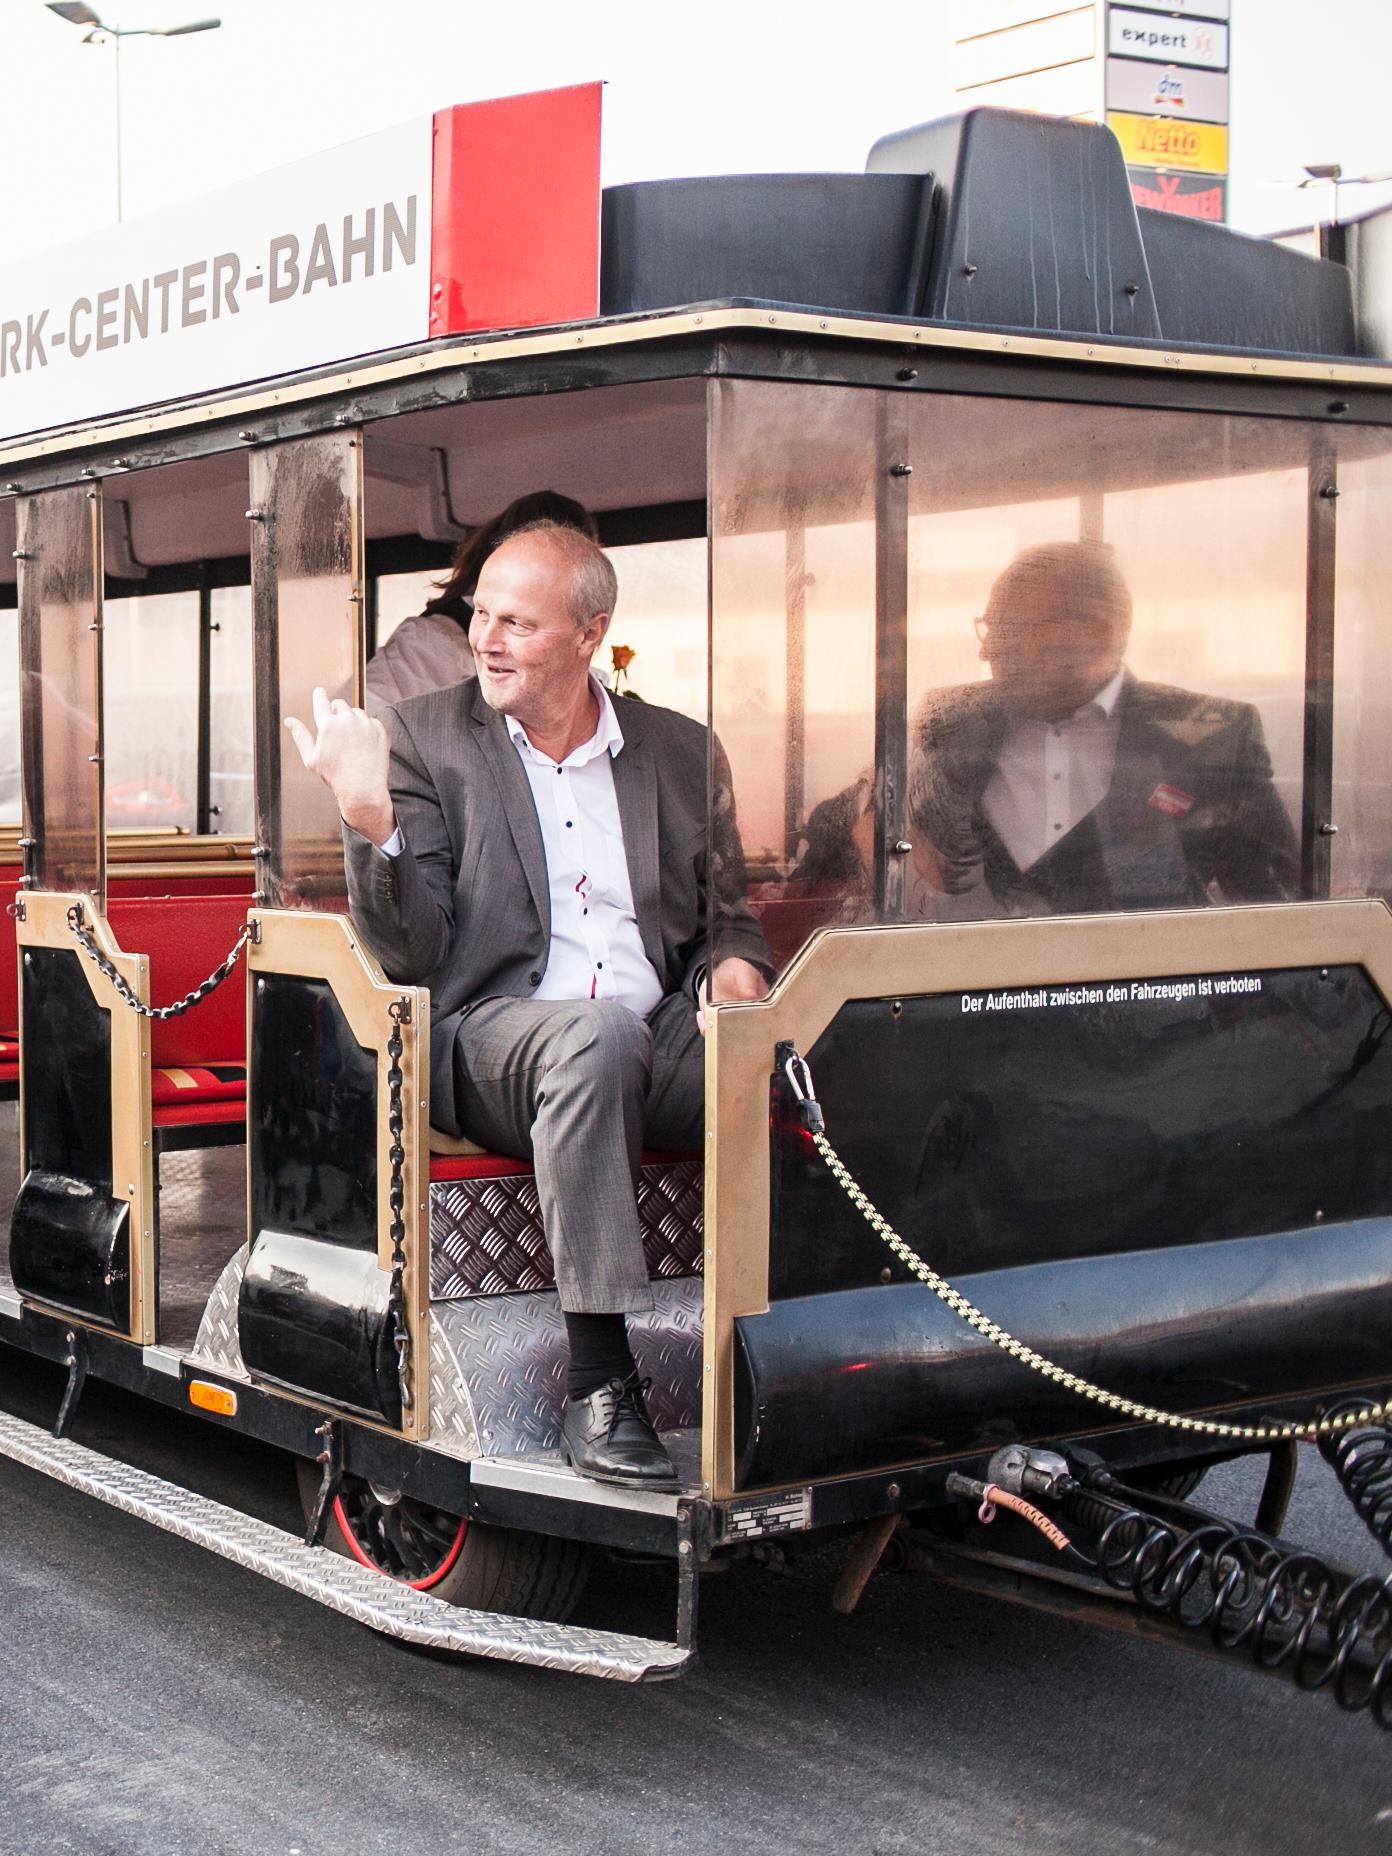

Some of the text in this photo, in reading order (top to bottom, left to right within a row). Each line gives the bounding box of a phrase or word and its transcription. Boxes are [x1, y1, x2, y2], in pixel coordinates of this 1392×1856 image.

[1121, 27, 1186, 48] expert
[1158, 73, 1183, 96] dm
[1137, 119, 1200, 155] Netto
[961, 976, 1262, 1013] Der Aufenthalt zwischen den Fahrzeugen ist verboten
